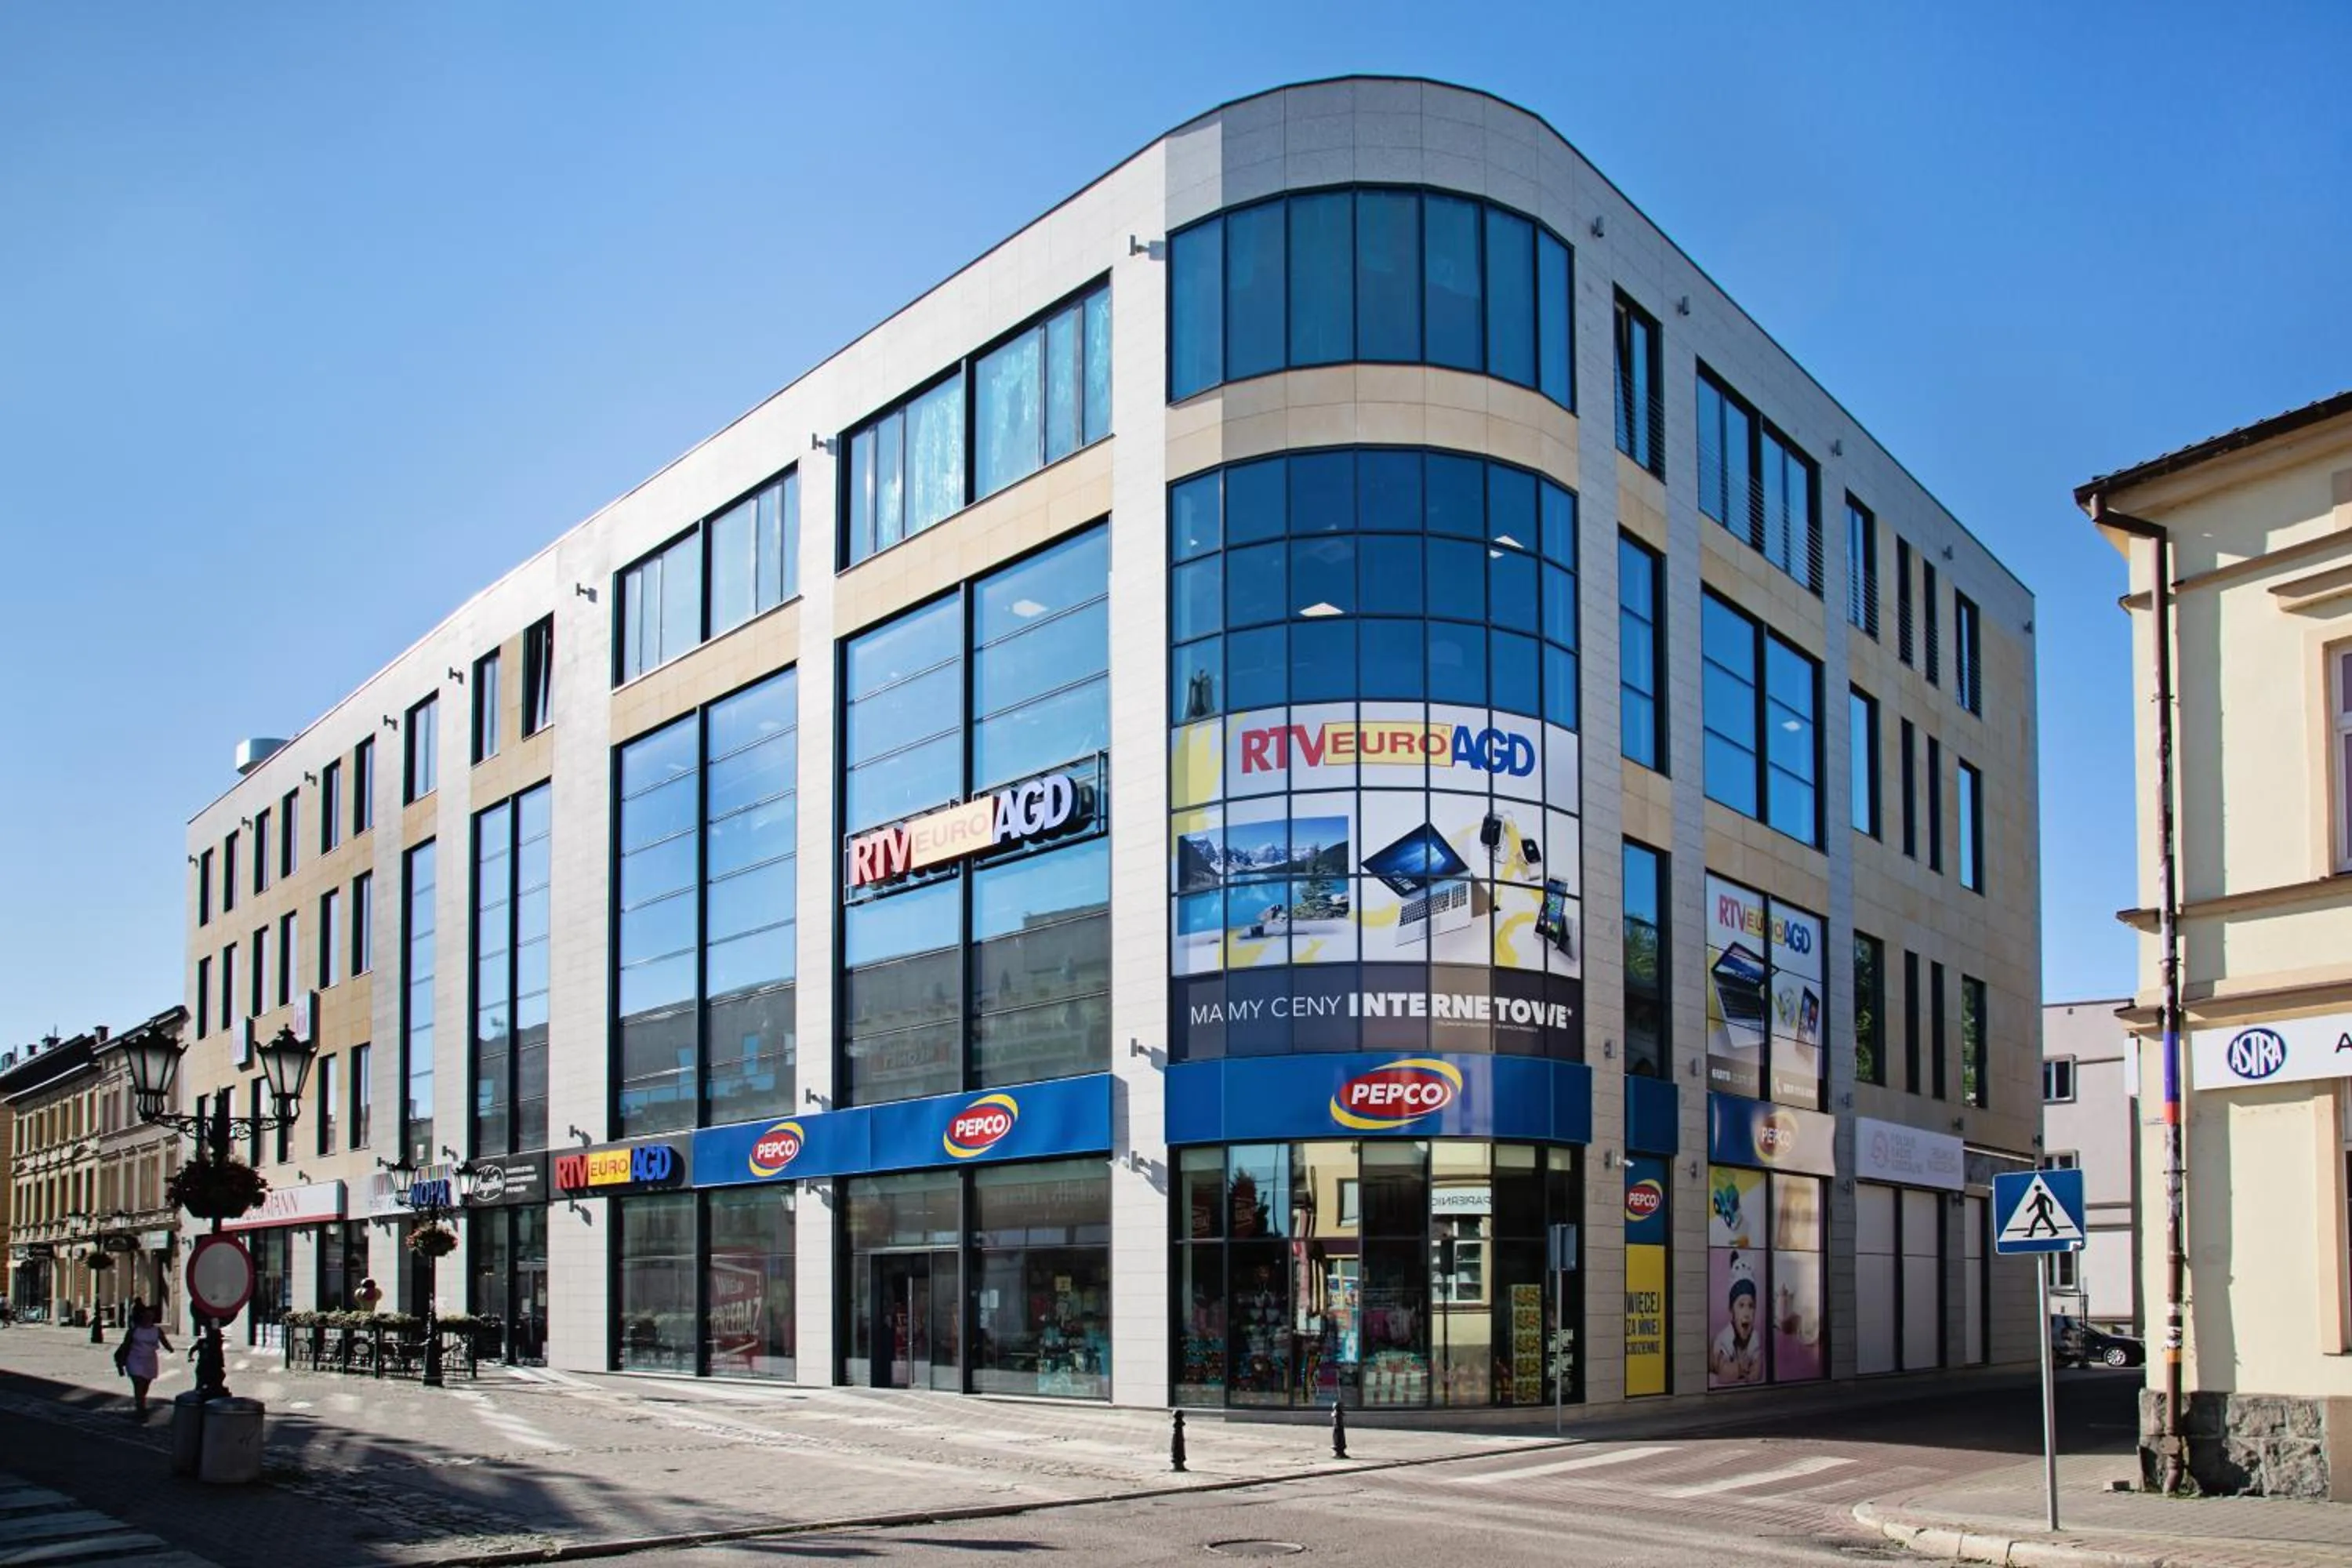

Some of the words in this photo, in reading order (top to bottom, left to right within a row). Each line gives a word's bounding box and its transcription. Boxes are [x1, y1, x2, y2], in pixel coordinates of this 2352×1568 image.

[1241, 724, 1325, 774] RTV
[1332, 731, 1447, 755] EURO
[1452, 725, 1536, 777] AGD
[851, 826, 913, 887] RTV
[915, 812, 989, 854] EURO
[994, 774, 1073, 844] AGD
[1719, 895, 1746, 931] RTV
[1747, 909, 1783, 938] EUO
[1784, 920, 1812, 954] AGD
[1191, 1000, 1264, 1025] MAMY
[1271, 996, 1341, 1017] CENY
[2231, 1031, 2283, 1076] ASTRA
[1351, 1083, 1443, 1105] PEPCO
[955, 1114, 1006, 1138] PEPCO
[1762, 1127, 1792, 1147] PEPCO
[757, 1139, 796, 1160] PEPCO
[555, 1154, 588, 1190] RTV
[590, 1159, 628, 1177] EURO
[631, 1145, 672, 1181] AGD
[1628, 1192, 1657, 1207] PEPCO
